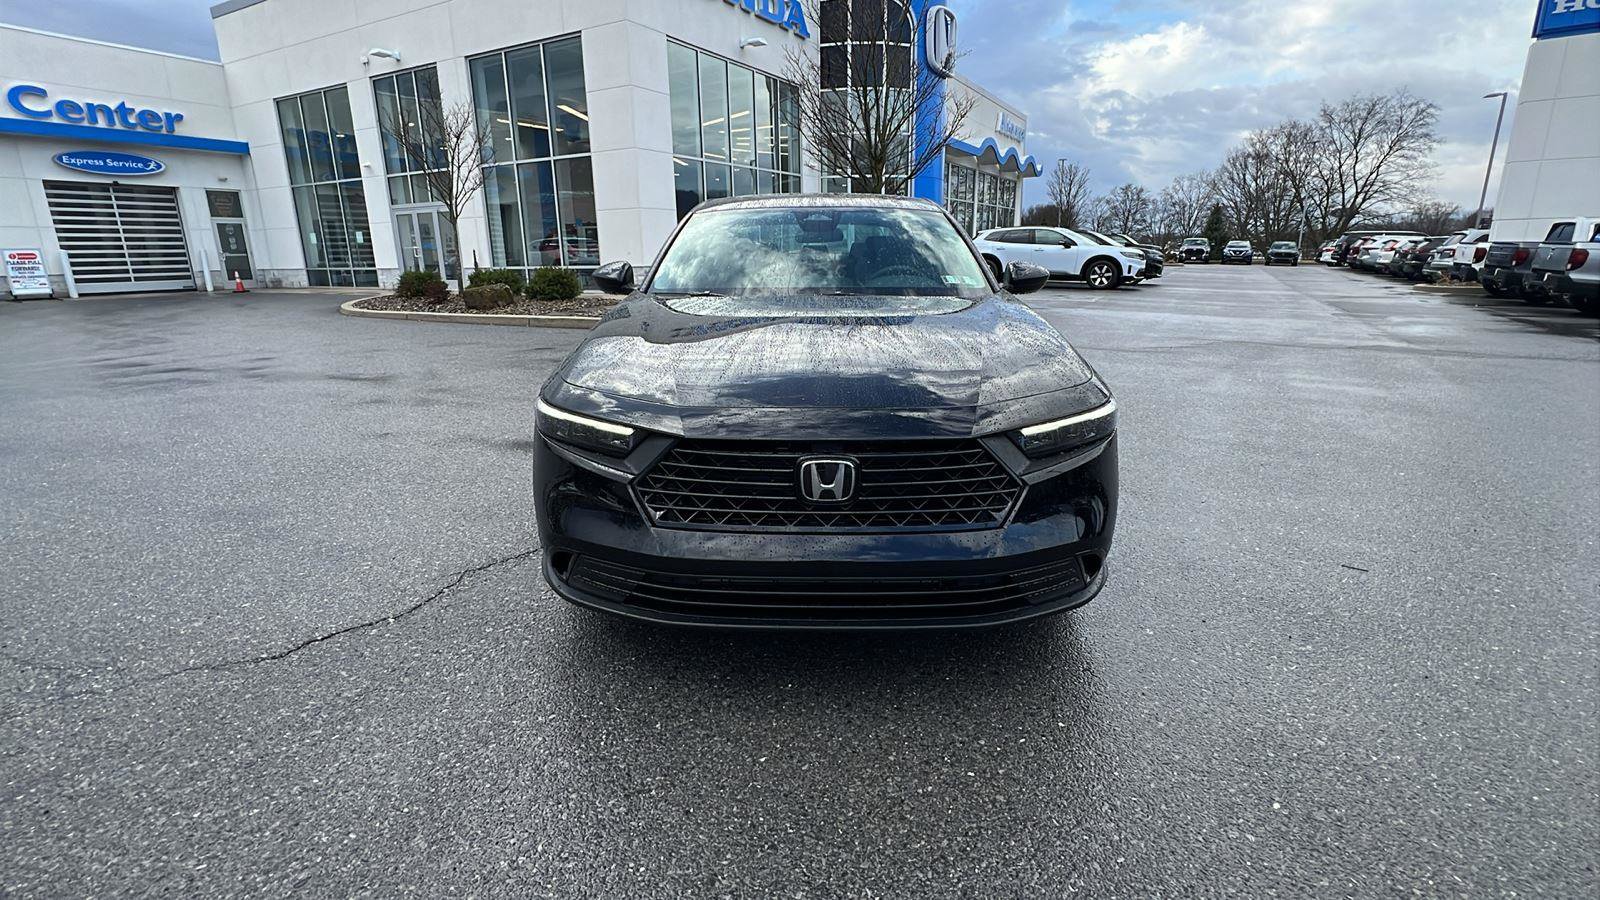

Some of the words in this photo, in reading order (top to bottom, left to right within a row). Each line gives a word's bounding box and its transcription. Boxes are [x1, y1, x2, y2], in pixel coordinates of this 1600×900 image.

[723, 0, 810, 38] DA
[7, 84, 184, 134] Center
[62, 155, 104, 166] Express
[106, 158, 144, 169] Service
